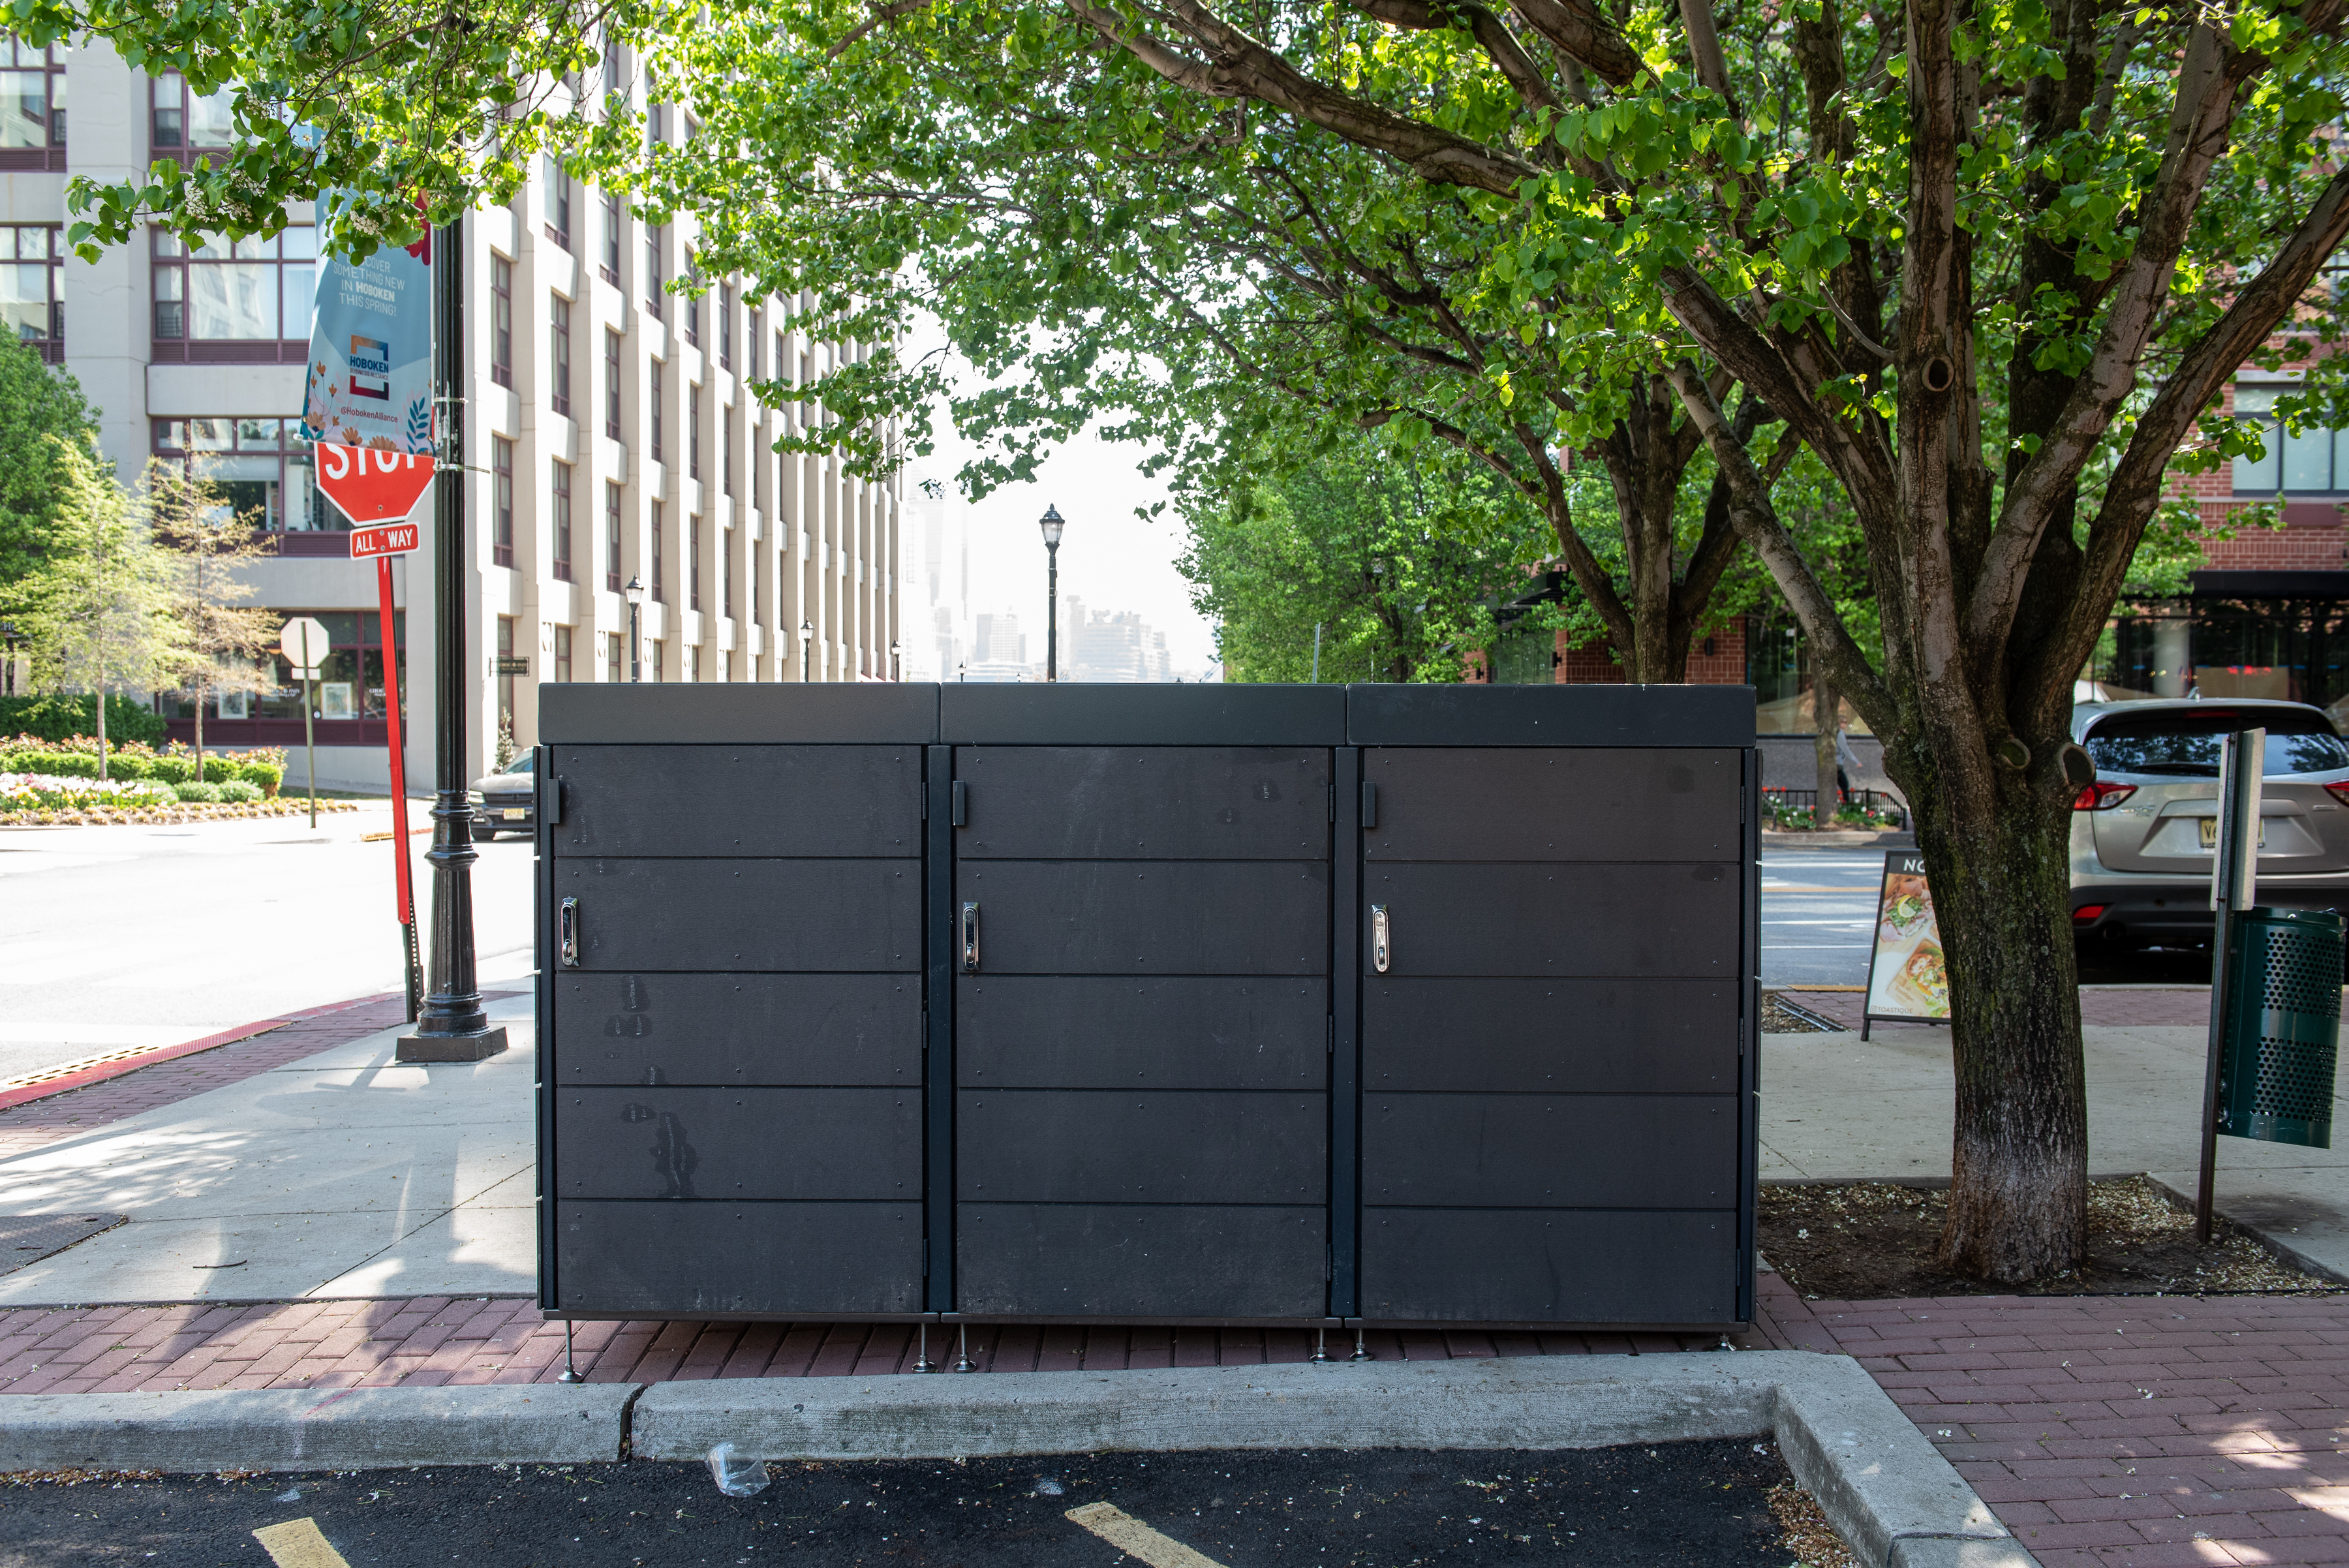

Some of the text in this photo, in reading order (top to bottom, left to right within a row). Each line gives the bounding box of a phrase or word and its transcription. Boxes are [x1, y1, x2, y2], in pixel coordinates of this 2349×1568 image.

[346, 253, 390, 273] COVER
[333, 262, 405, 290] SOMETHING NEW
[341, 279, 395, 302] IN HOBOKEN
[339, 292, 396, 316] THIS SPRING!
[350, 356, 389, 373] HOBOKEN
[350, 367, 389, 381] BUSINESS ALLIANCE
[341, 406, 398, 423] @HobokenAlliance
[326, 443, 414, 480] STO
[356, 529, 413, 553] ALL WAY
[1878, 1006, 1913, 1015] TOASTIQUE
